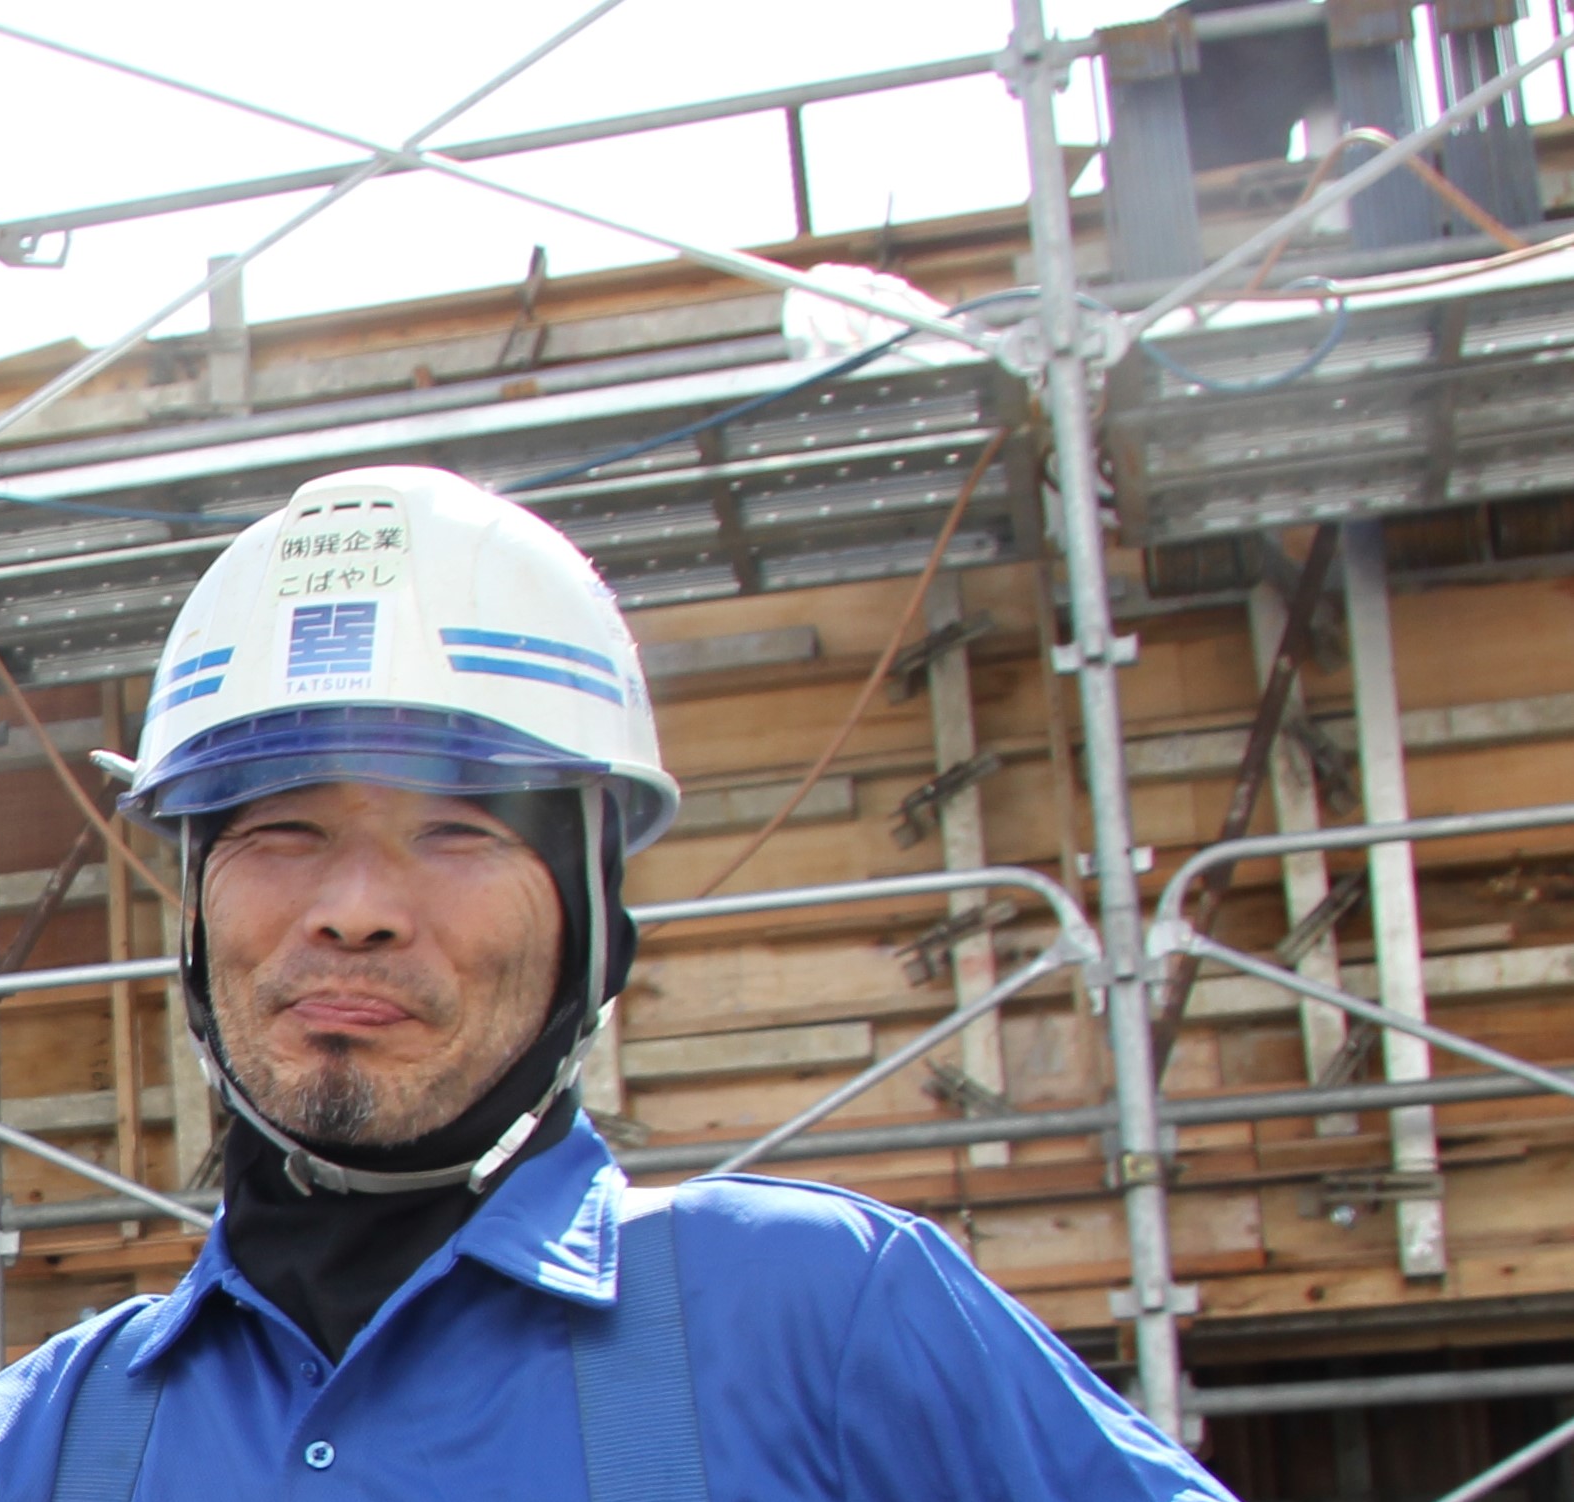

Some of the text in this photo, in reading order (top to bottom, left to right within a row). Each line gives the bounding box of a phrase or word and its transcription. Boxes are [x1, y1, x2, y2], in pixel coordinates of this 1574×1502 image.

[279, 566, 395, 596] こばやし
[286, 677, 372, 694] TATSUMI
